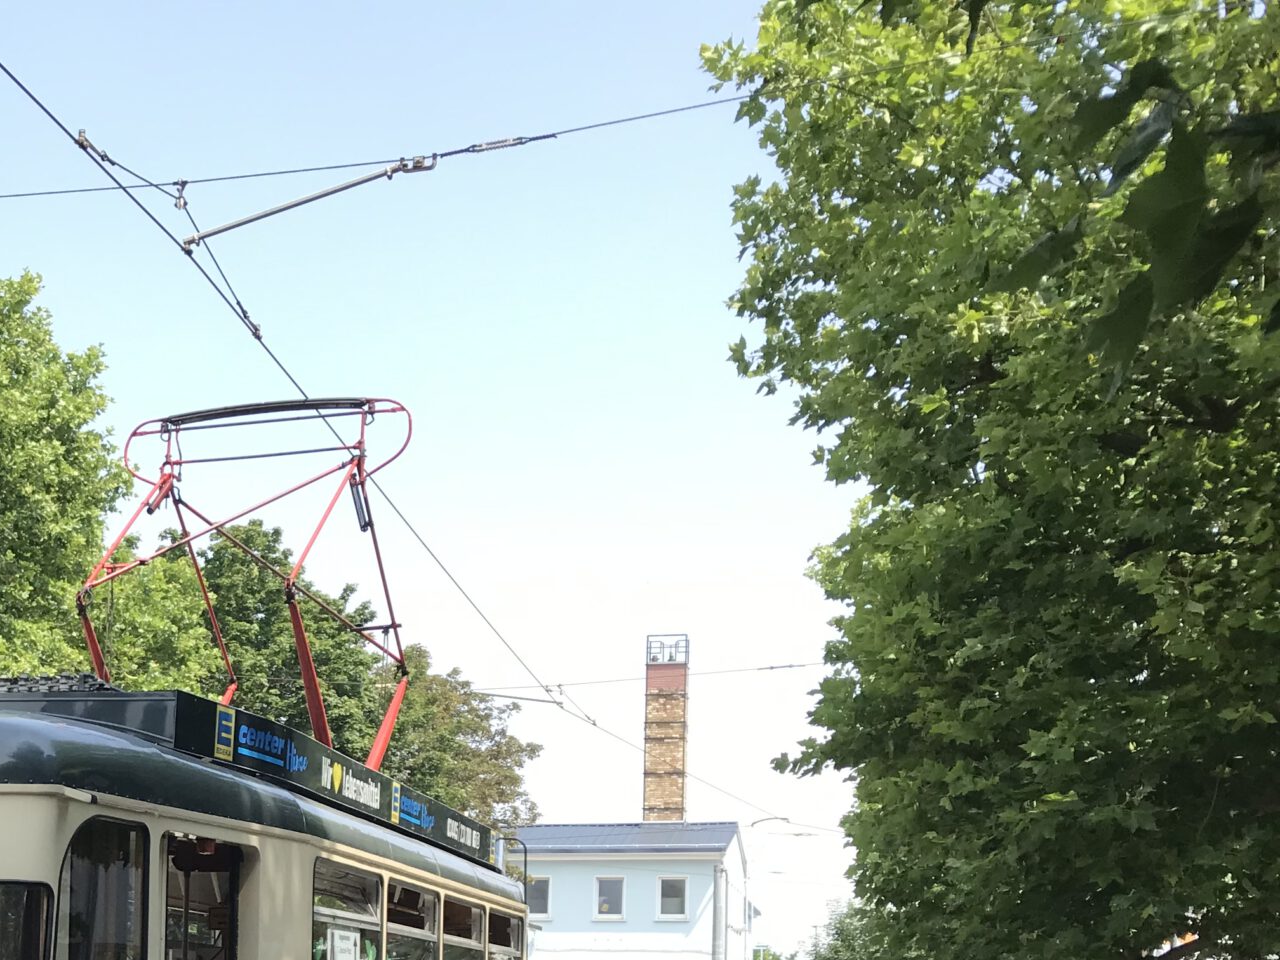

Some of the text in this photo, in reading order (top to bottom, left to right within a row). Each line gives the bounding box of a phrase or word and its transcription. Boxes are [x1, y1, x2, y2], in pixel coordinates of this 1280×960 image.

[217, 710, 233, 747] E
[238, 724, 286, 755] center
[321, 755, 381, 810] Wir Lebensmittel
